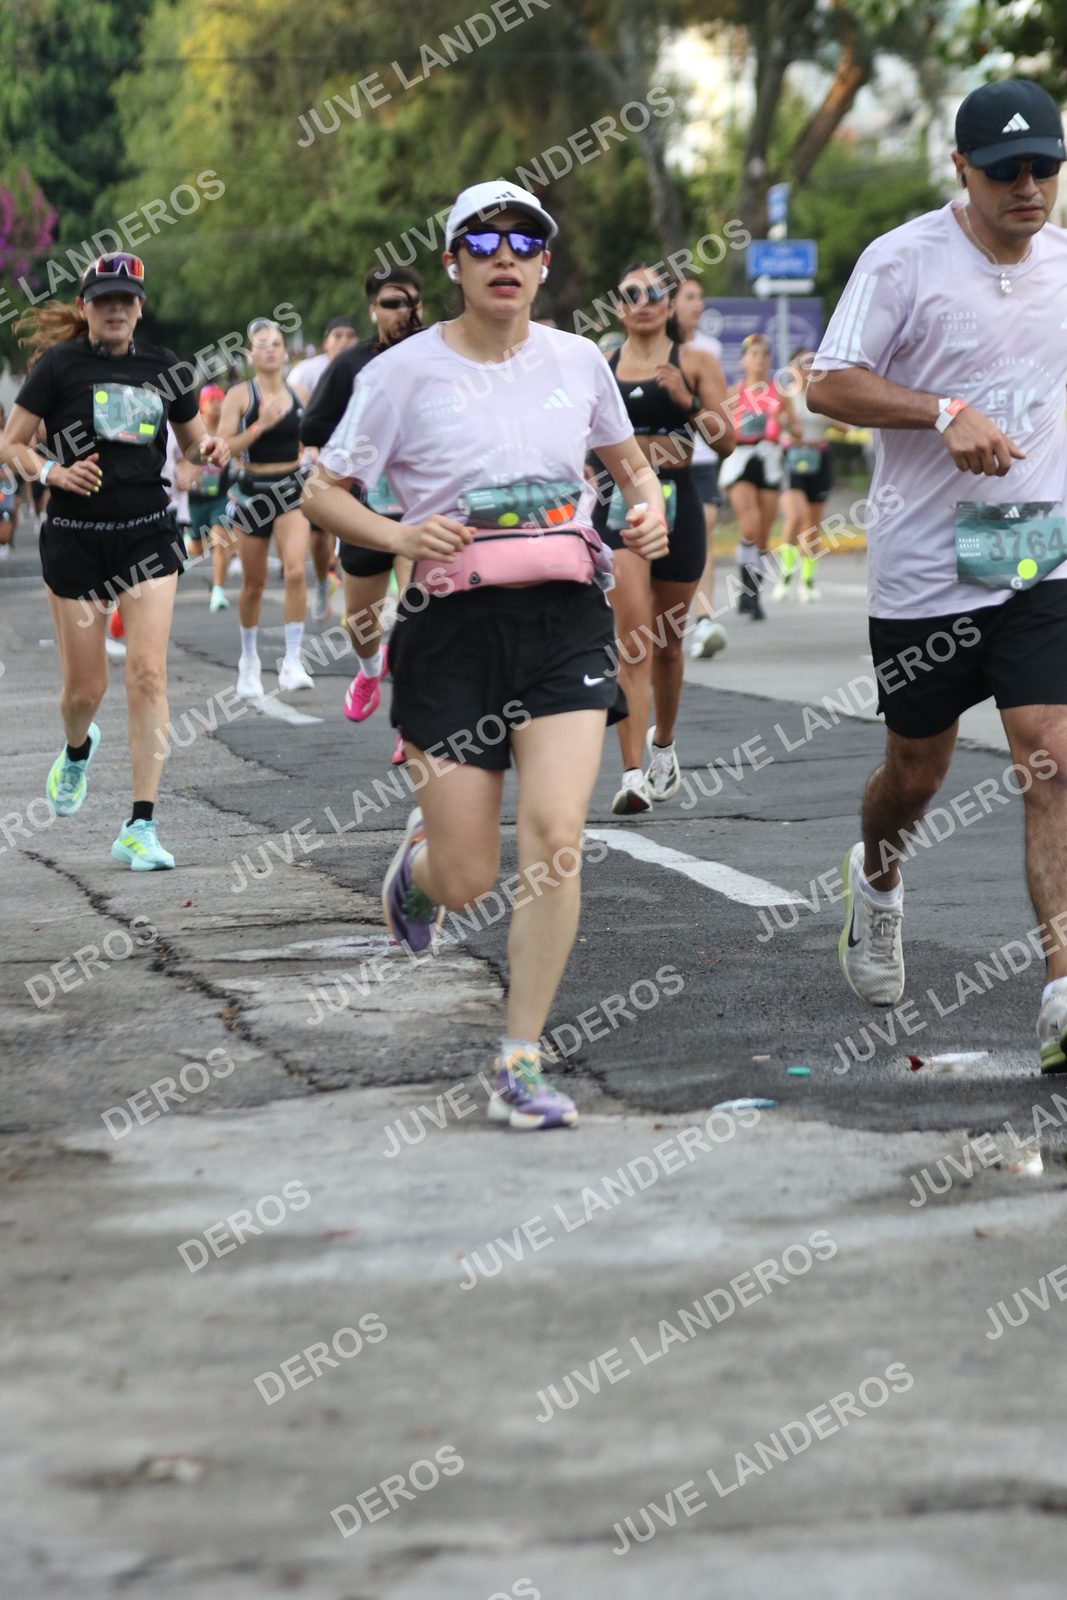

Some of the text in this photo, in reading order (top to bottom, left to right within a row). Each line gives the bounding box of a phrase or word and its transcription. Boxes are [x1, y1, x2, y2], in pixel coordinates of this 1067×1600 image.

[985, 389, 1008, 410] 15
[1010, 389, 1037, 433] K
[985, 527, 1067, 562] 3764
